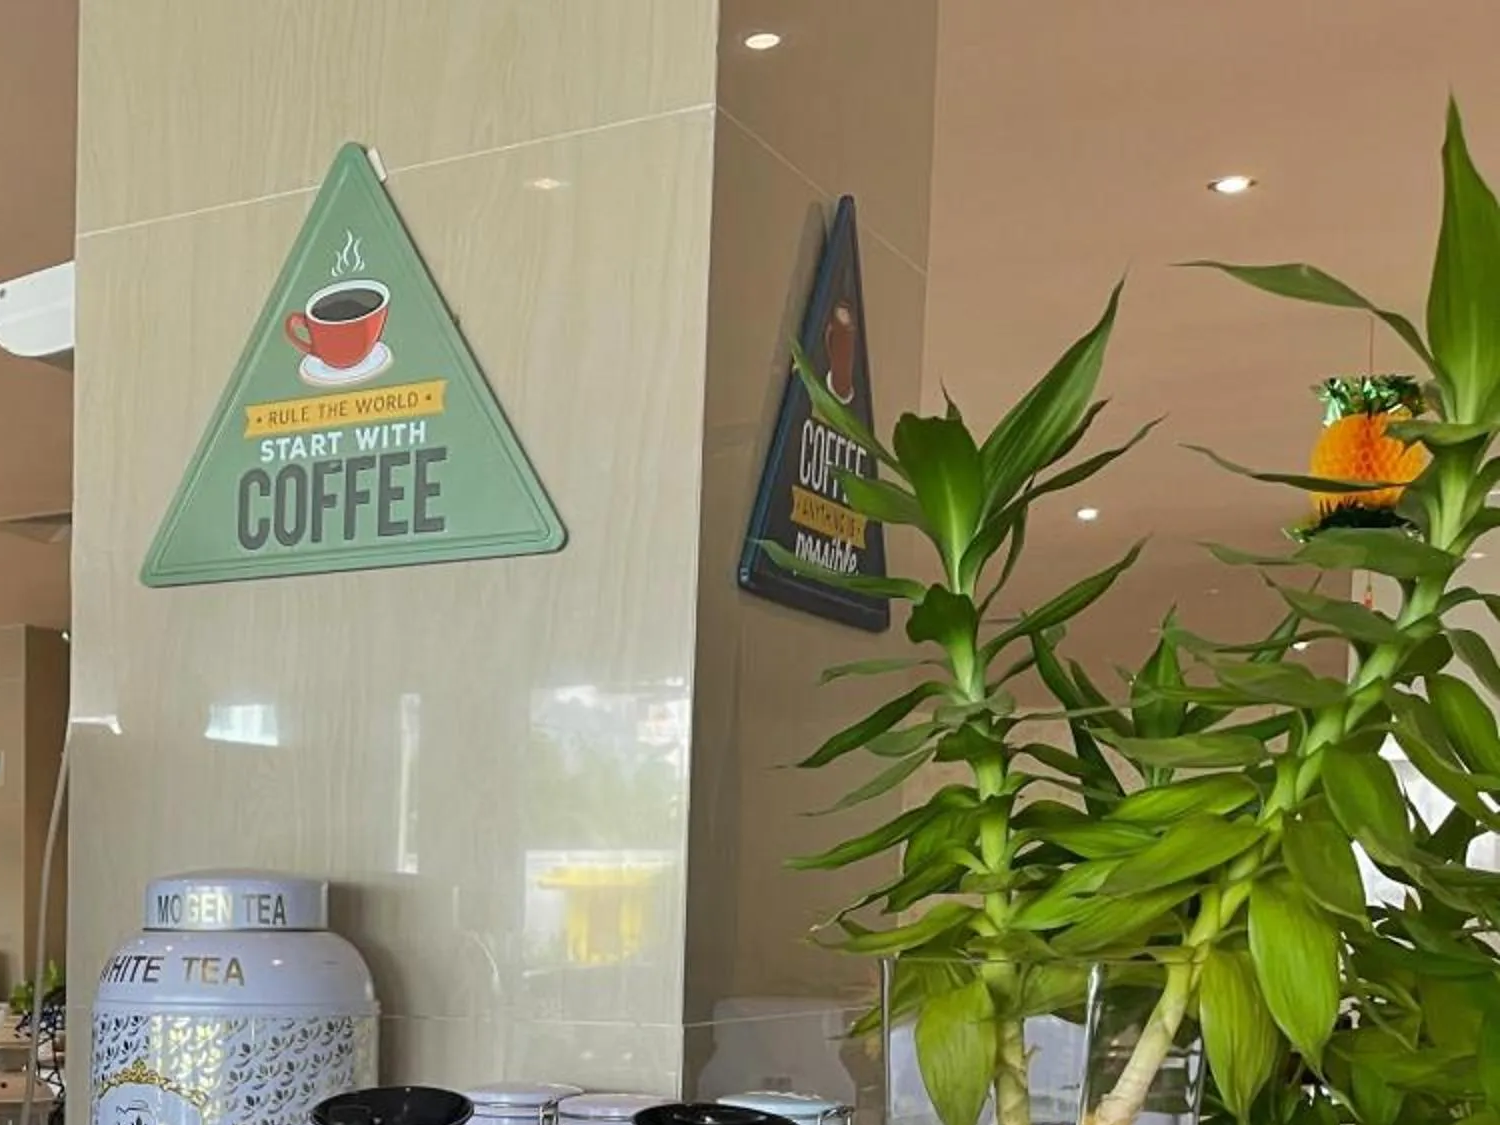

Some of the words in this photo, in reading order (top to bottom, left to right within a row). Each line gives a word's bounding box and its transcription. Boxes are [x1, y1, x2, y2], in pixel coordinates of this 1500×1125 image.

[268, 406, 309, 426] RULE
[318, 399, 349, 419] THE
[356, 391, 420, 414] WORLD
[260, 431, 343, 463] START
[355, 420, 426, 451] WITH
[237, 447, 447, 550] COFFEE
[157, 892, 232, 924] MOGEN
[242, 893, 287, 925] TEA
[182, 956, 245, 987] TEA
